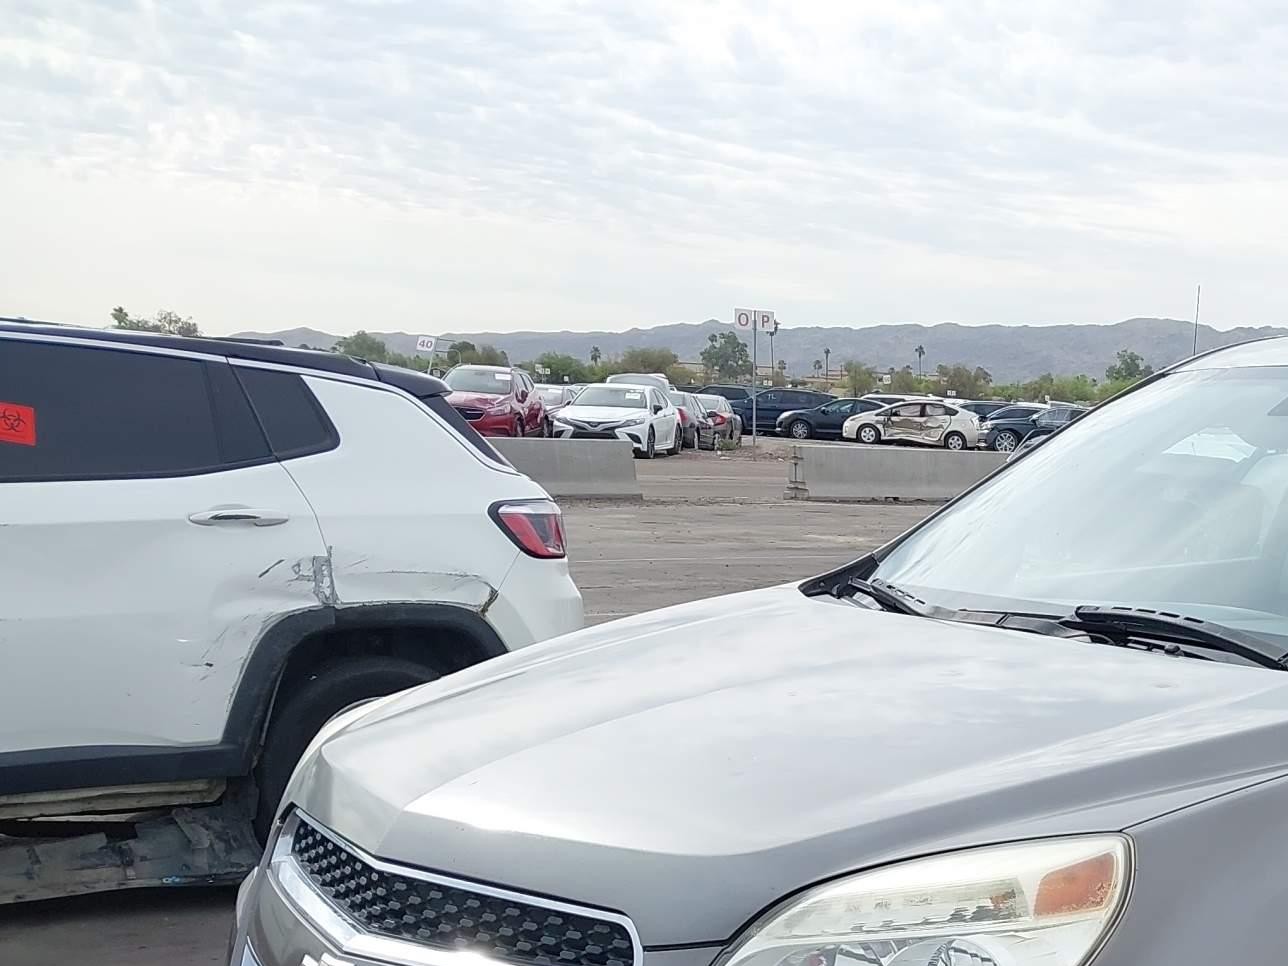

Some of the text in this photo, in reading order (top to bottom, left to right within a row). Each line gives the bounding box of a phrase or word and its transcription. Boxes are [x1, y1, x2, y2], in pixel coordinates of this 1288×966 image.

[738, 312, 749, 327] O
[761, 314, 770, 328] P
[418, 339, 433, 349] 40
